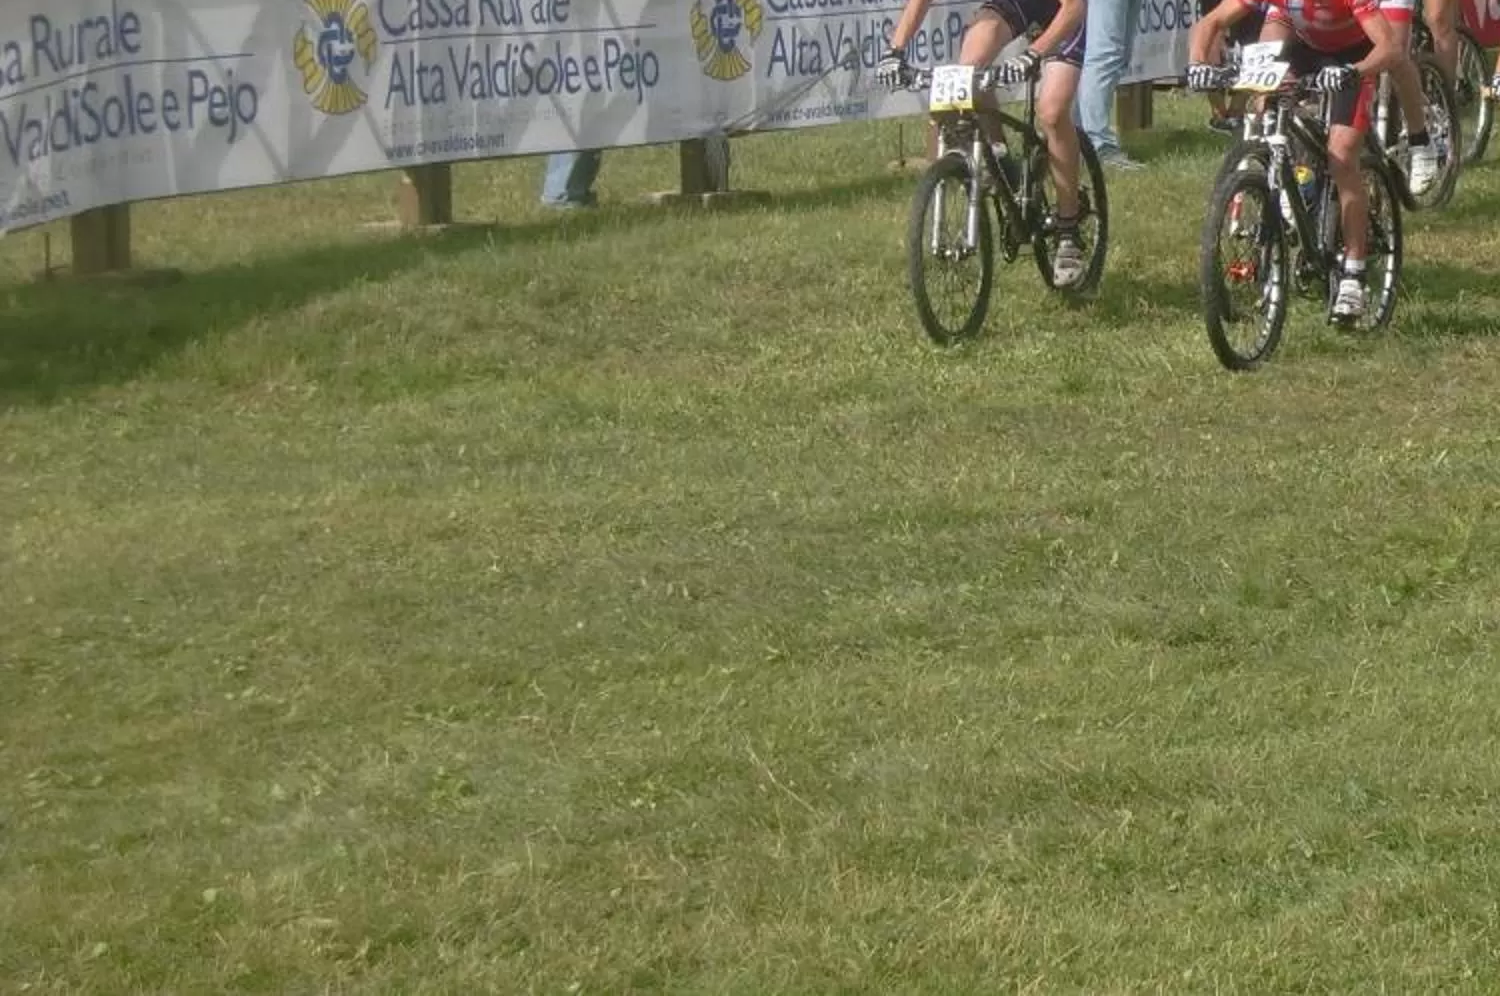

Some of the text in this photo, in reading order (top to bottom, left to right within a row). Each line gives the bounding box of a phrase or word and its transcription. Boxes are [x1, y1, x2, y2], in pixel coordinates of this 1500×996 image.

[385, 45, 446, 109] Alta
[583, 55, 602, 94] e
[604, 37, 660, 106] Pejo
[767, 26, 823, 79] Alta
[162, 89, 181, 132] e
[188, 69, 258, 144] Pejo
